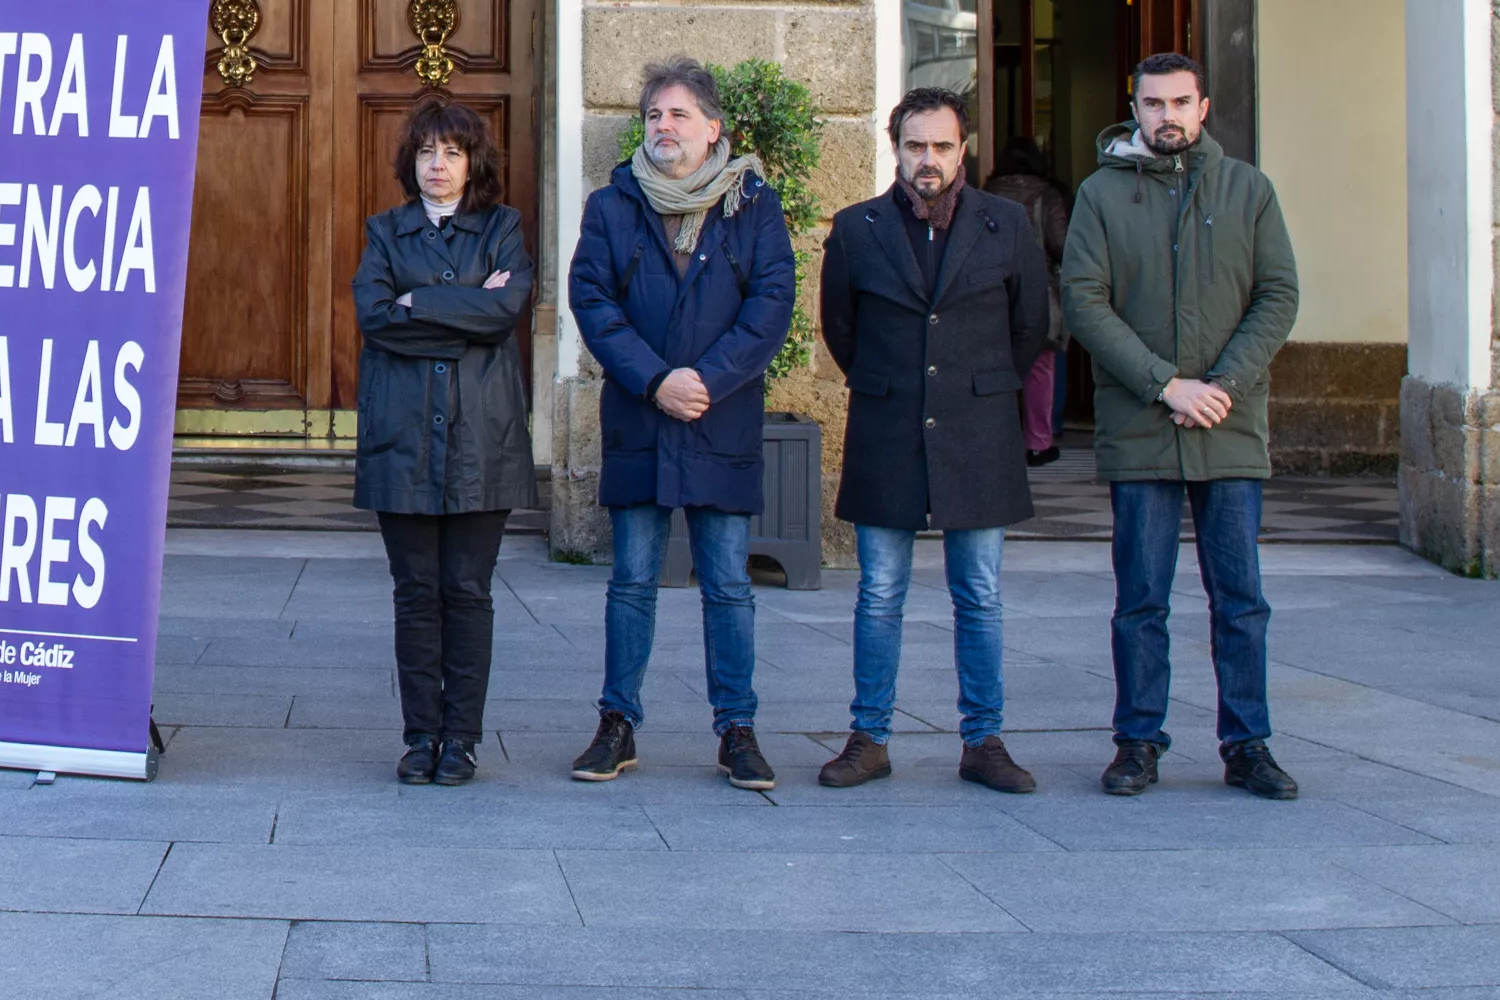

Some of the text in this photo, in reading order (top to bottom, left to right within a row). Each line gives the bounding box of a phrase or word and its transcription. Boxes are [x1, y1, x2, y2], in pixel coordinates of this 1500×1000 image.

[109, 35, 180, 140] LA
[35, 339, 145, 451] LAS
[3, 670, 13, 683] la
[13, 671, 42, 687] Mujer
[19, 641, 74, 668] Cádiz
